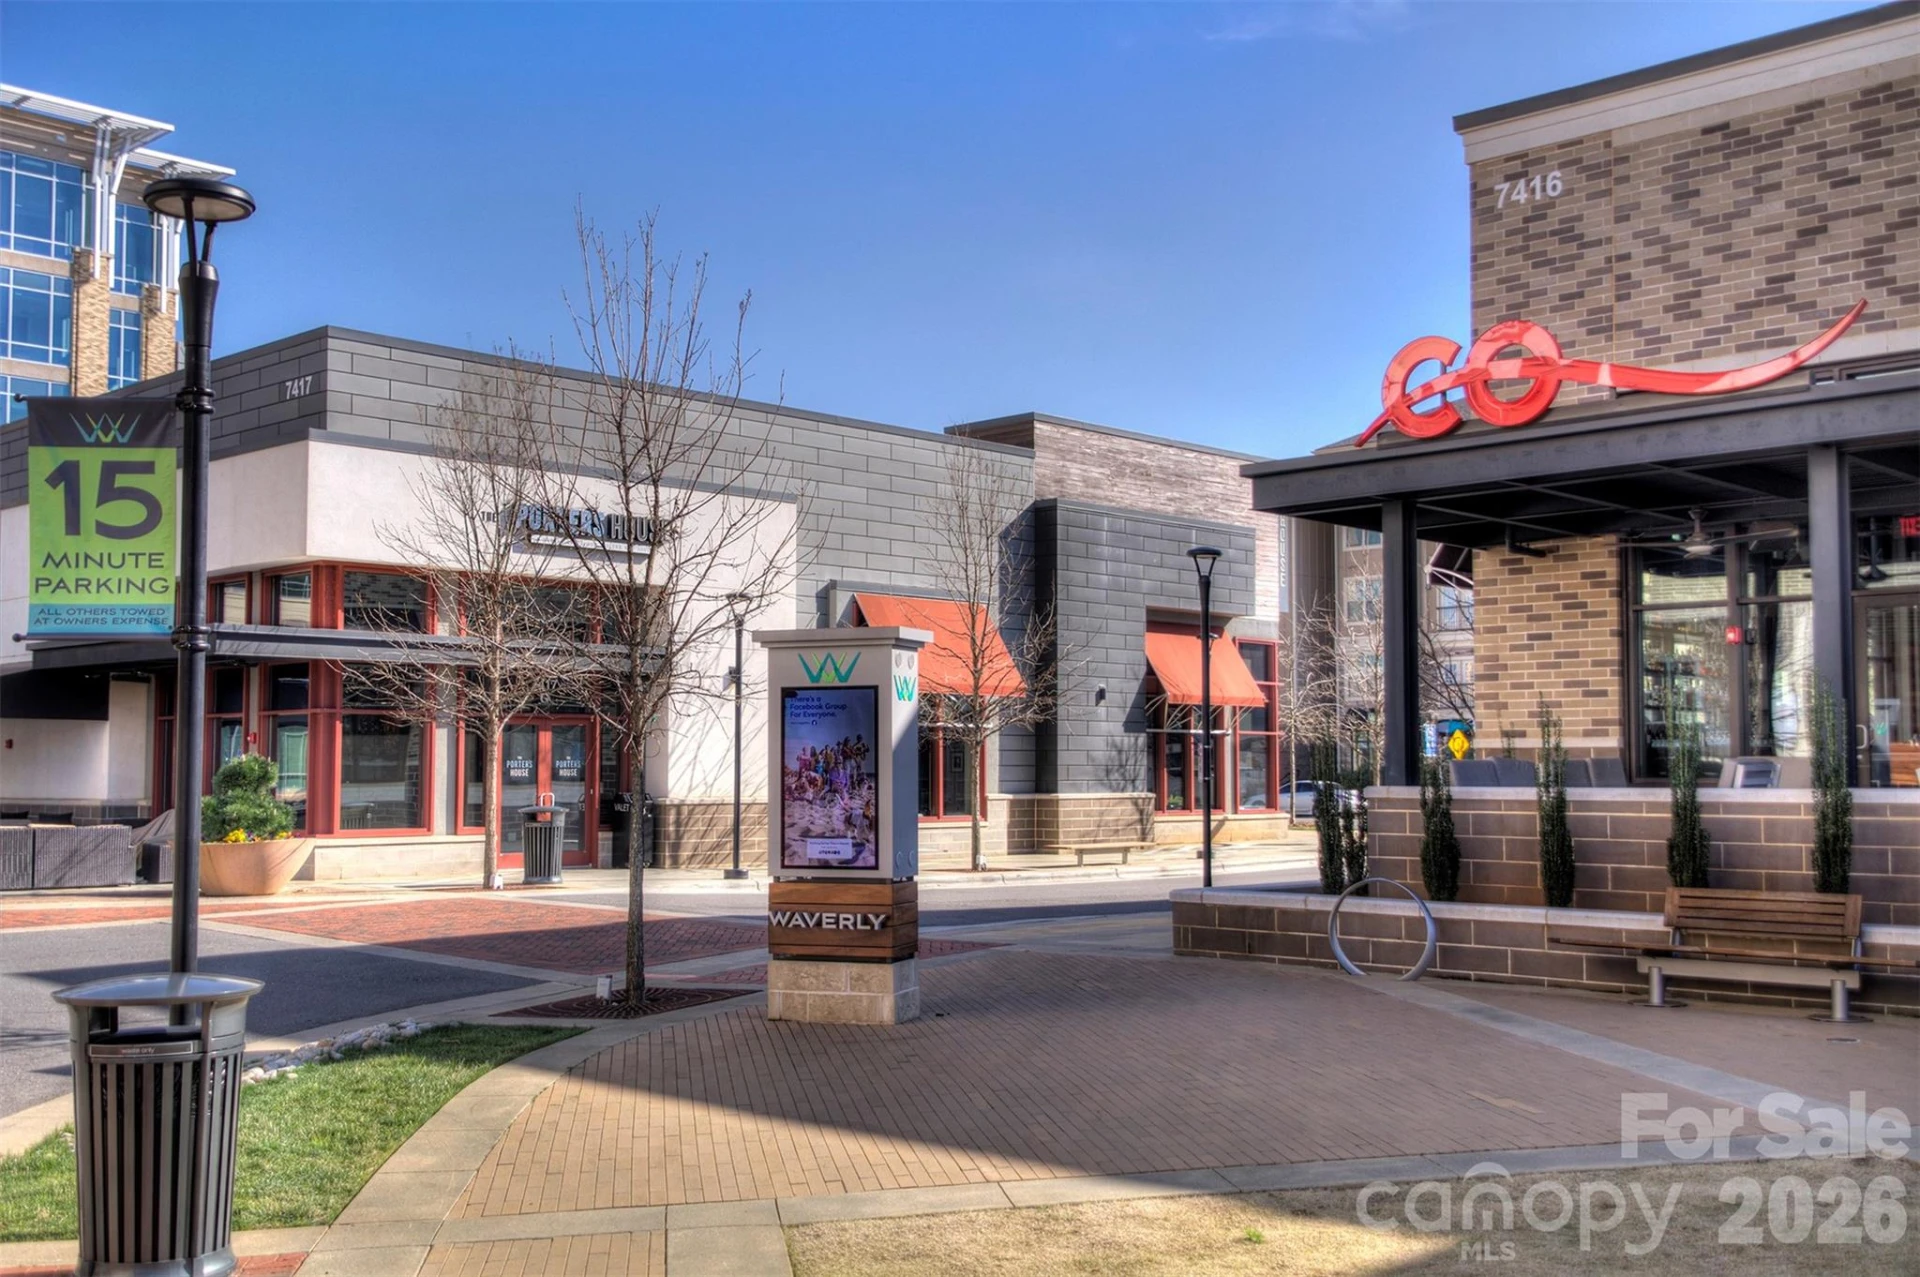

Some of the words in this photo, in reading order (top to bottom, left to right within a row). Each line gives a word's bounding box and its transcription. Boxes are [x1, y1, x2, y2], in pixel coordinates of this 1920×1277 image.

[1494, 170, 1563, 209] 7416
[285, 375, 313, 400] 7417
[44, 459, 163, 540] 15
[42, 551, 164, 569] MINUTE
[34, 577, 169, 594] PARKING
[38, 607, 61, 616] ALL
[66, 607, 116, 616] OTHERS
[120, 607, 165, 616] TOWED
[34, 617, 50, 625] AT
[54, 617, 107, 625] OWNERS
[112, 617, 168, 626] EXPENSE
[825, 703, 848, 711] Group
[510, 768, 529, 777] HOUSE
[559, 768, 577, 777] HOUSE
[614, 803, 630, 812] VALET
[768, 910, 887, 931] WAVERLY
